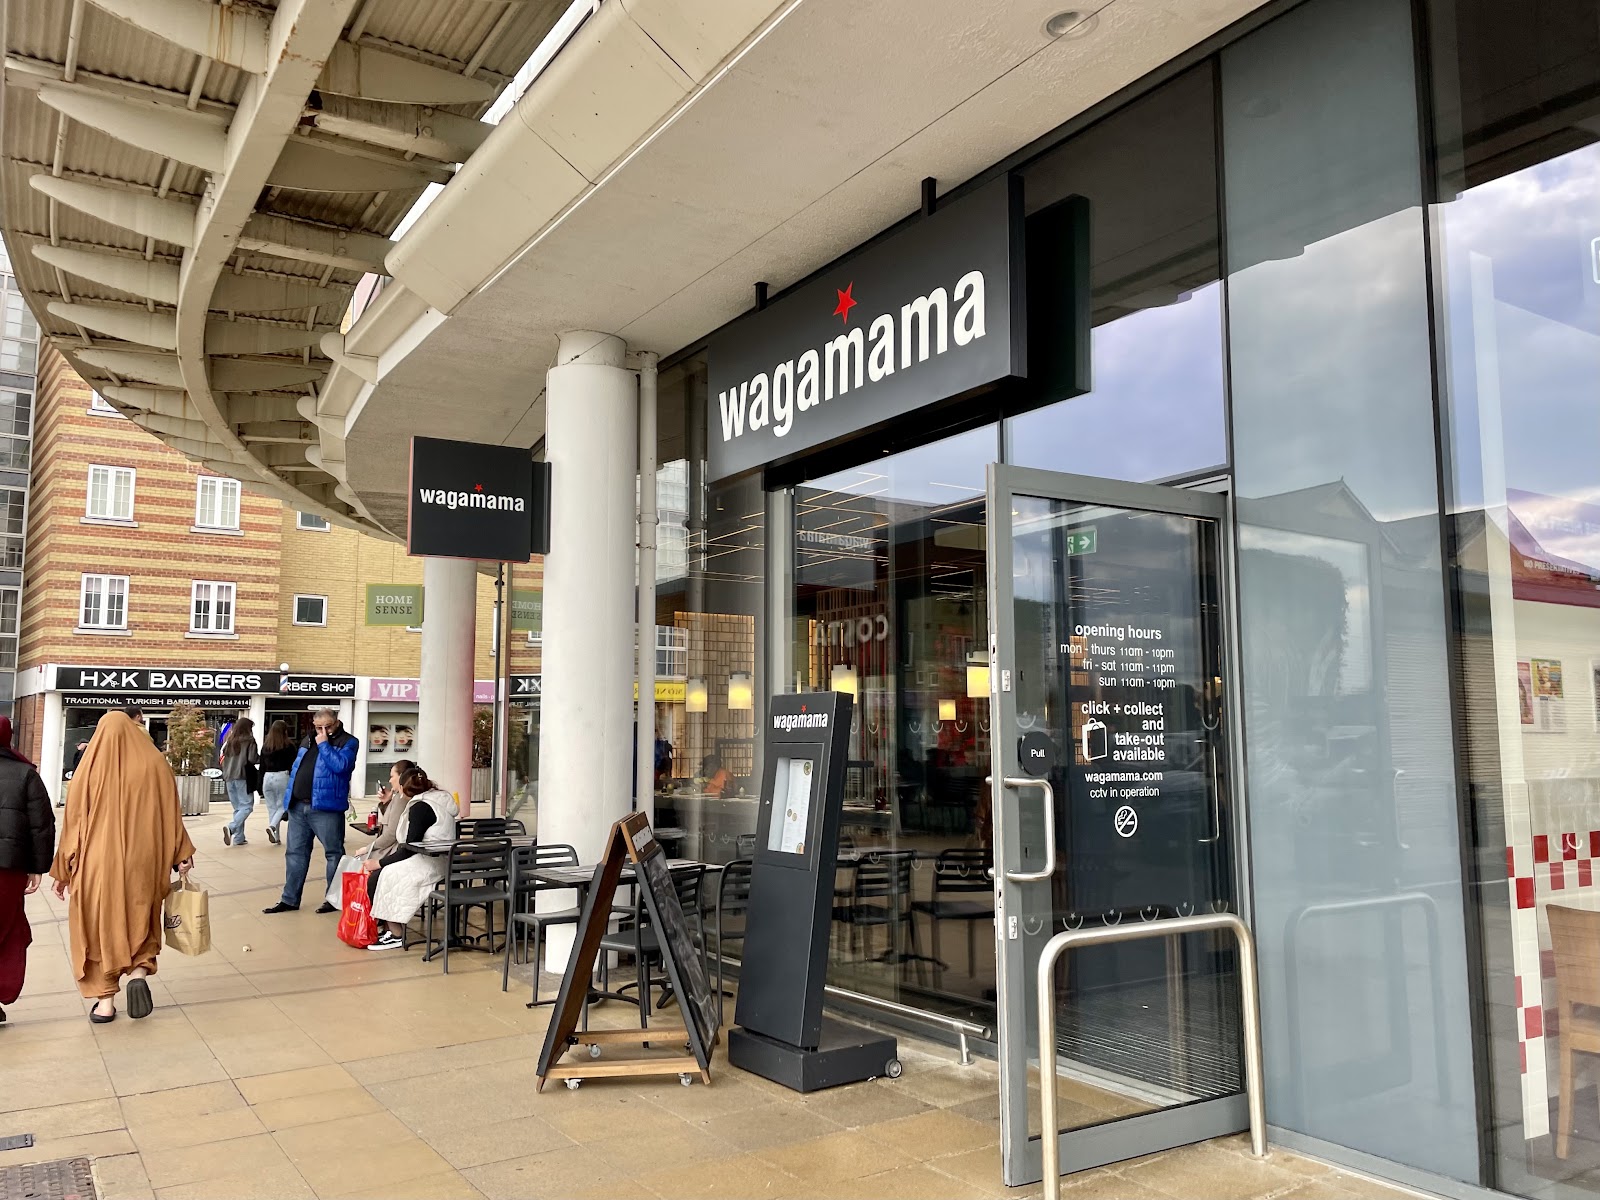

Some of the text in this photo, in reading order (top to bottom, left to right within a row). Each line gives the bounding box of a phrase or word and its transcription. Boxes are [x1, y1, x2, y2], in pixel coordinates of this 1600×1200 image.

[719, 270, 986, 442] wagamama
[420, 488, 525, 512] wagamama
[375, 595, 413, 605] HOME
[375, 605, 413, 615] SENSE
[1075, 624, 1162, 640] opening hours
[1060, 643, 1082, 654] mon
[1091, 643, 1116, 656] thurs
[1120, 647, 1144, 657] 11am
[1151, 648, 1175, 660] 10pm
[1083, 658, 1093, 670] fri
[1101, 660, 1117, 671] sat
[1121, 662, 1144, 672] 11am
[1152, 663, 1175, 675] 11pm
[150, 672, 262, 690] BARBERS
[287, 682, 354, 692] RBER SHOP
[1098, 676, 1117, 687] sun
[1121, 678, 1145, 688] 11am
[1153, 679, 1176, 691] 10pm
[378, 683, 413, 698] VIP
[64, 697, 123, 705] TRADITIONAL
[166, 698, 201, 706] BARBER
[1081, 700, 1164, 716] click + collect
[773, 712, 829, 733] wagamama
[1142, 717, 1164, 731] and
[1115, 732, 1165, 746] take-out
[1030, 748, 1046, 758] Pull
[1113, 746, 1165, 761] available
[1085, 771, 1163, 784] wagamama.com
[1089, 786, 1160, 799] cctv in operation
